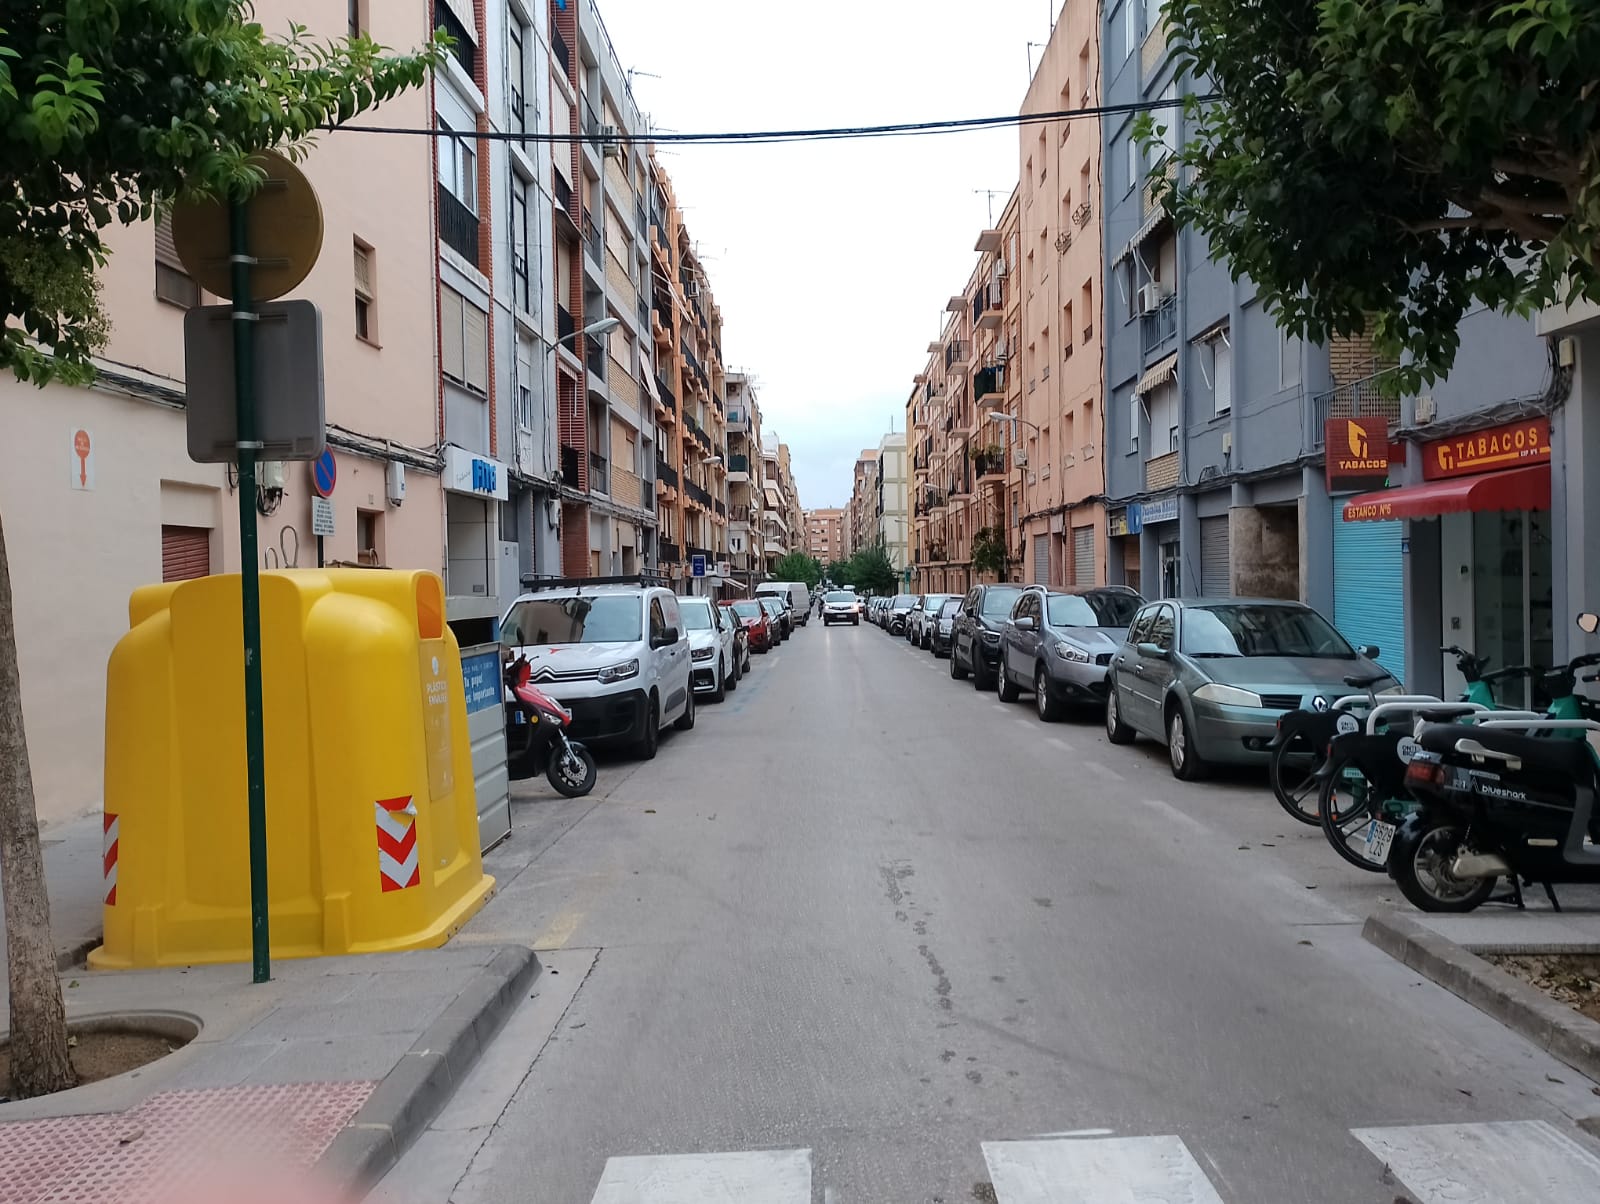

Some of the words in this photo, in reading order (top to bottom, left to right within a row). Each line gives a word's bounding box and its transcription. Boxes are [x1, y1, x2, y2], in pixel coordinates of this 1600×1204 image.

[1456, 427, 1538, 460] TABACOS
[1338, 459, 1388, 470] TABACOS
[1347, 504, 1377, 519] ESTANCO
[1481, 784, 1527, 800] blueshark
[1373, 825, 1394, 843] 6629
